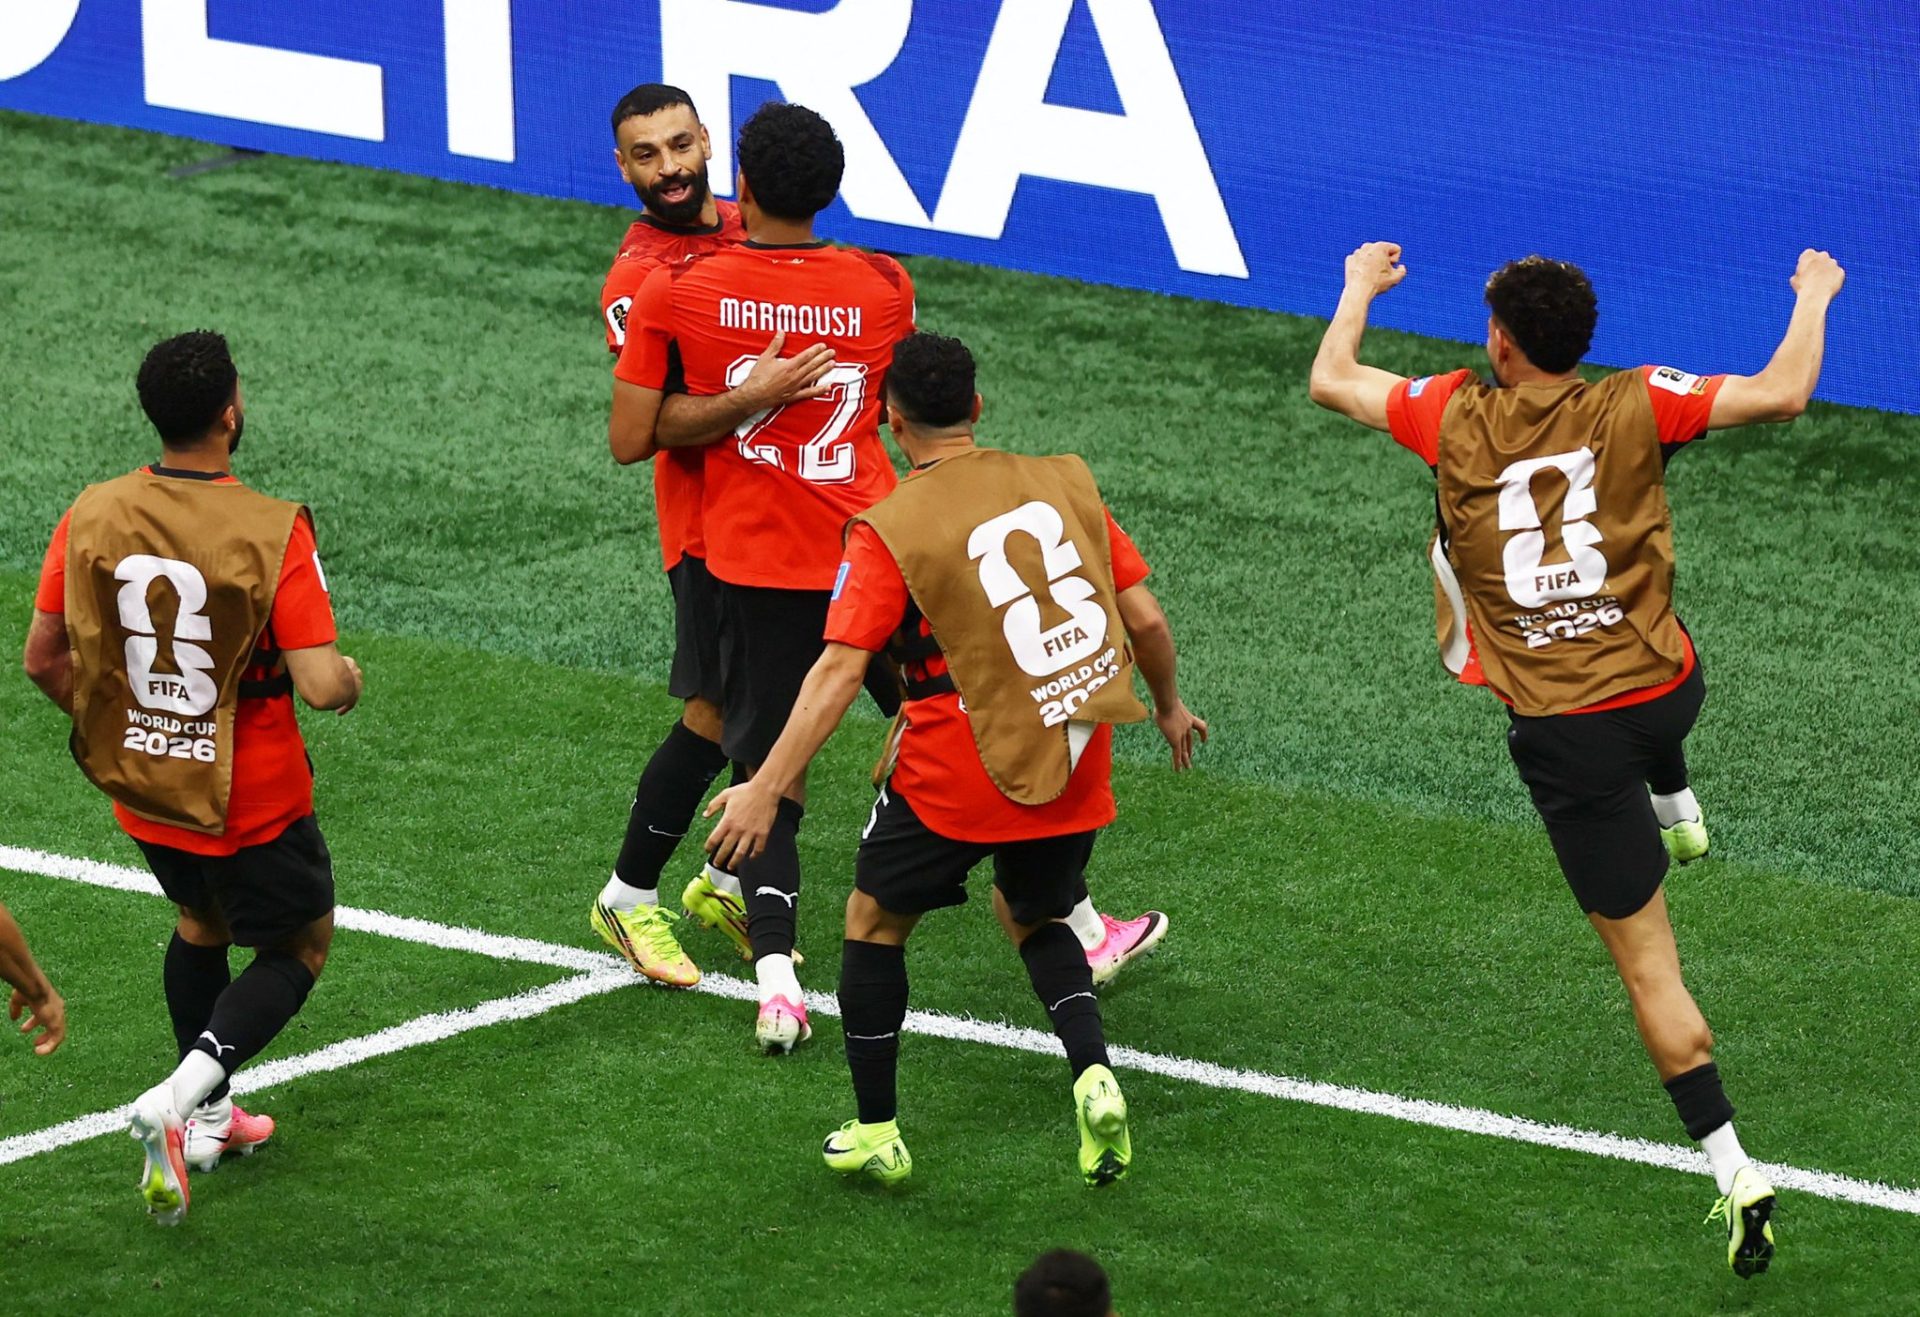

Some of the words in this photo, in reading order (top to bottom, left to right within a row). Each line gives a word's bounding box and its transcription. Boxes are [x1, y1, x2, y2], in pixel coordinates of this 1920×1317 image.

[719, 298, 862, 337] MARMOUSH
[1534, 569, 1581, 592] FIFA
[1043, 626, 1089, 658] FIFA
[1522, 602, 1624, 649] 2026
[148, 680, 191, 701] FIFA
[1030, 665, 1093, 703] WORLD
[1093, 647, 1116, 673] CUP
[127, 708, 182, 734] WORLD
[182, 722, 217, 736] CUP
[123, 726, 216, 763] 2026
